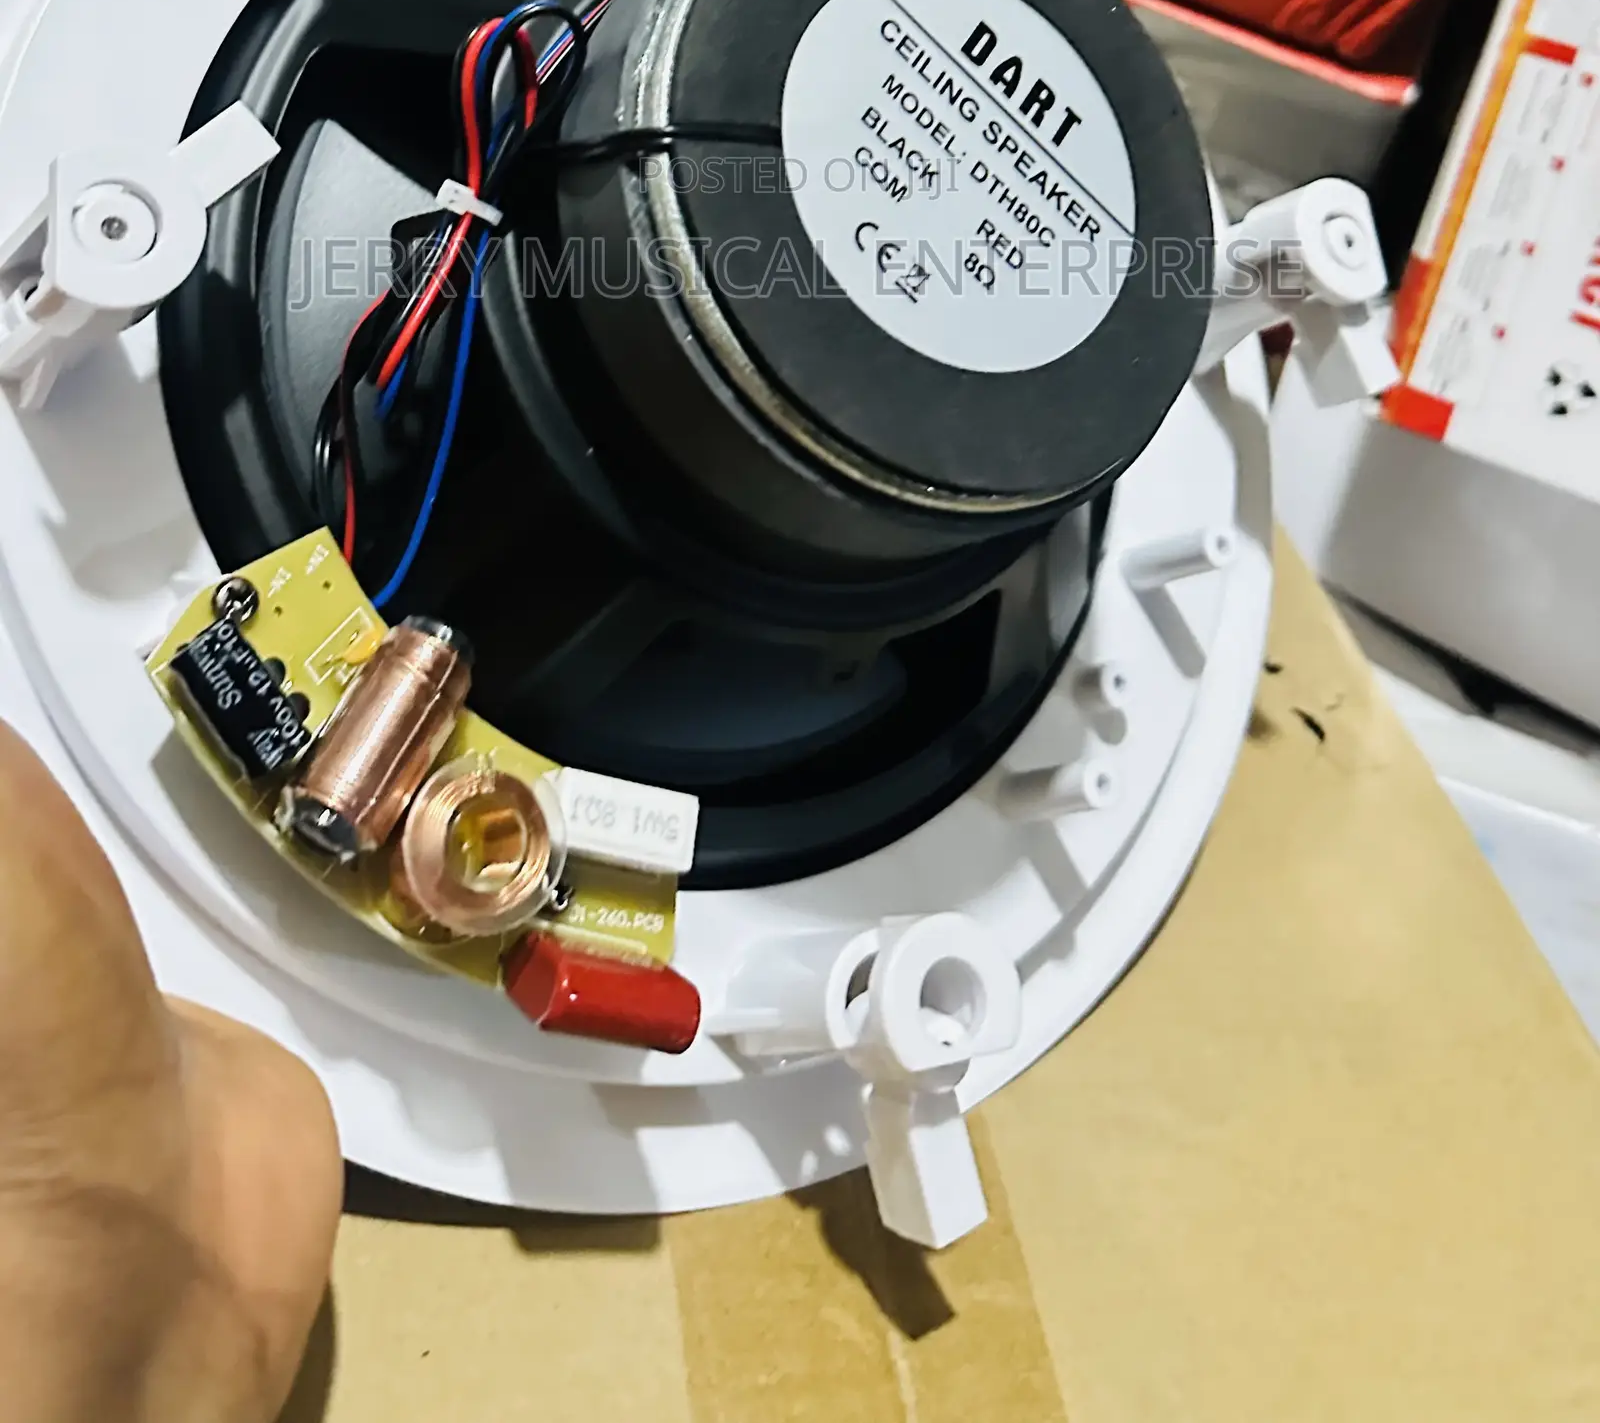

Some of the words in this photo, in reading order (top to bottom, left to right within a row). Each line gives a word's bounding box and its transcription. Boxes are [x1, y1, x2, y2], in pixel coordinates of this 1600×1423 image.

[880, 19, 980, 123] CEILING
[982, 120, 1101, 243] SPEAKER
[881, 73, 966, 164] MODEL:
[969, 160, 1057, 249] DTH80C
[960, 21, 1082, 147] DART
[854, 146, 908, 204] COM
[861, 106, 939, 188] BLACK
[976, 218, 1025, 271] RED
